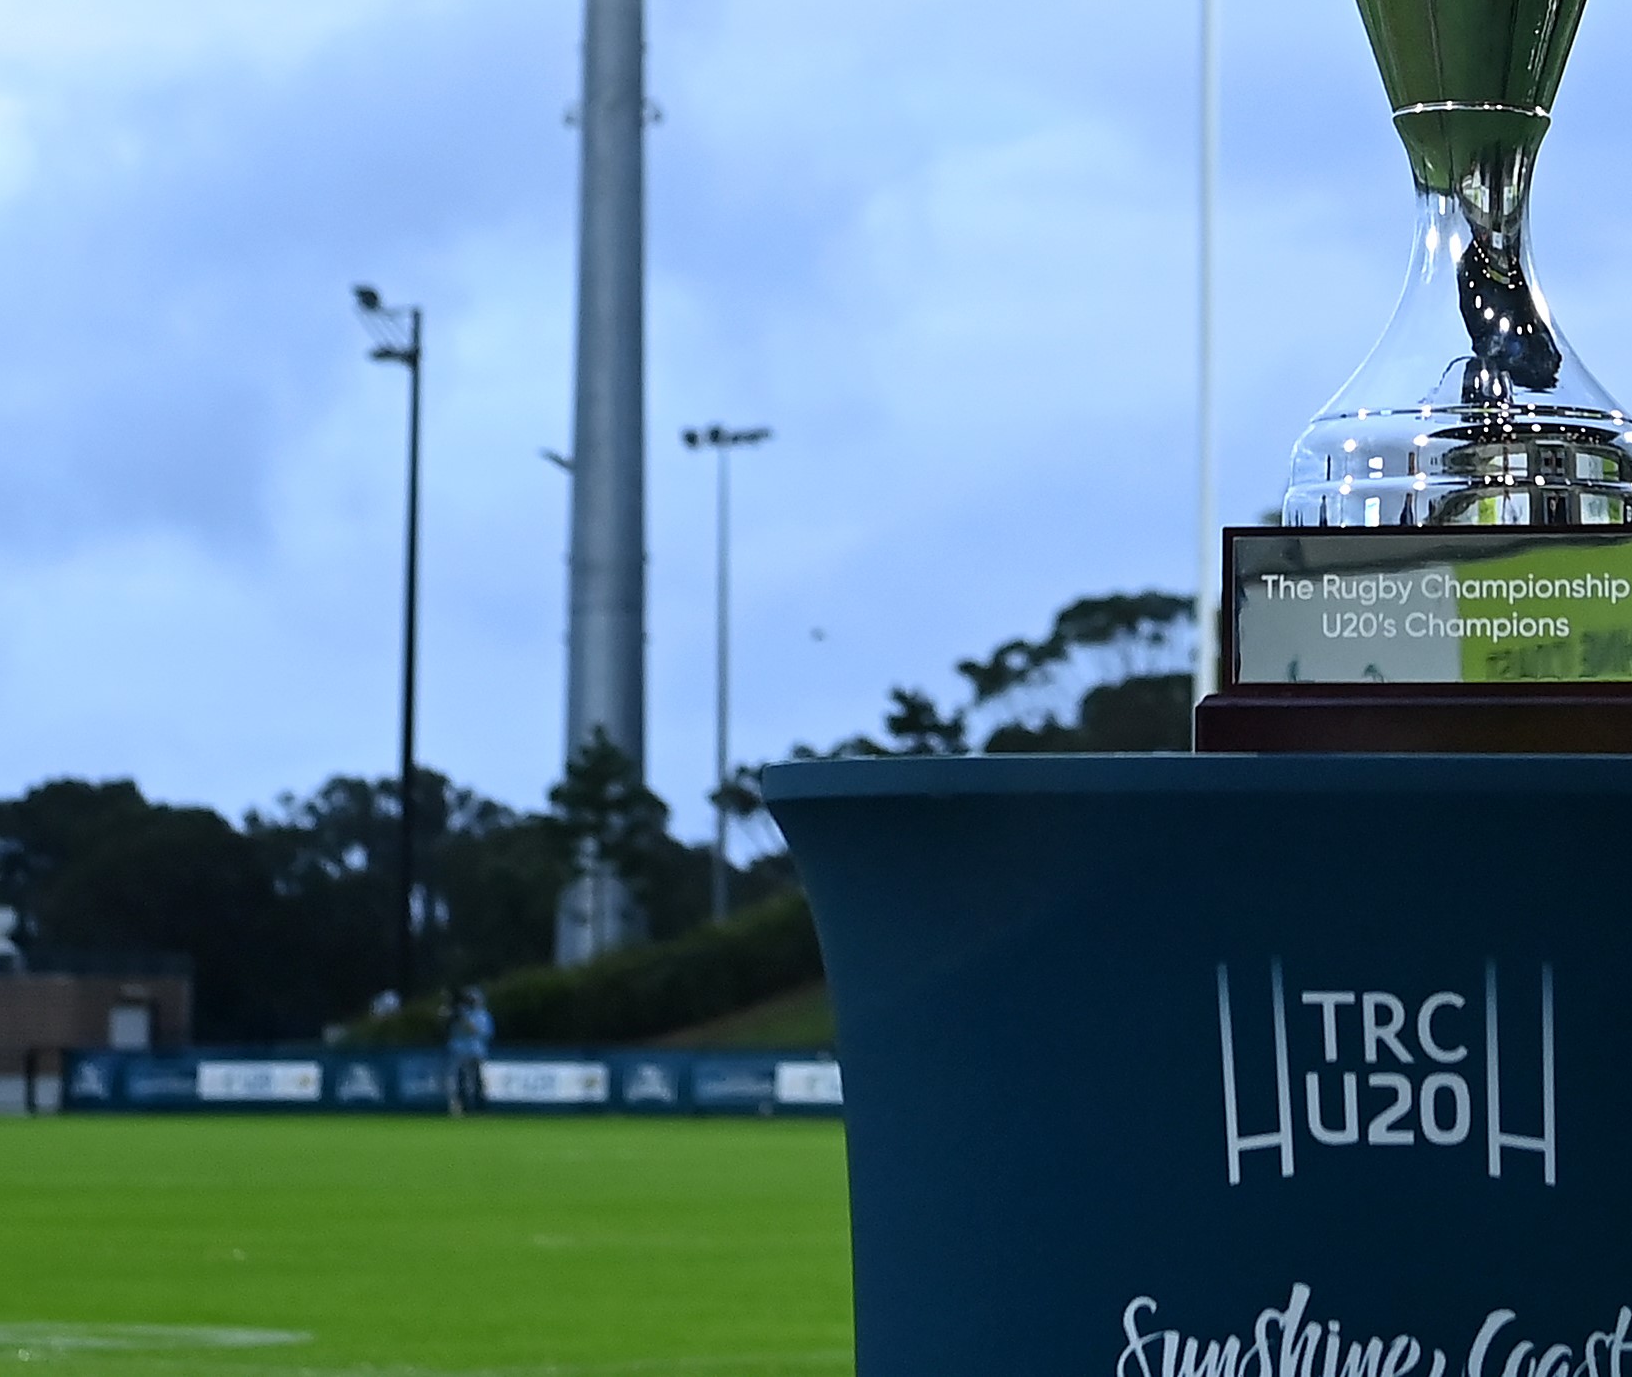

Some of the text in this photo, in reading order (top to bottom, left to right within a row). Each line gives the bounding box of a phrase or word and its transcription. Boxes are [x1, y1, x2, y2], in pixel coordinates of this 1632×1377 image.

[1261, 573, 1631, 605] The Rugby Championship
[1322, 612, 1570, 643] U20's Champions
[1302, 991, 1468, 1063] TRC
[1305, 1072, 1471, 1146] U20
